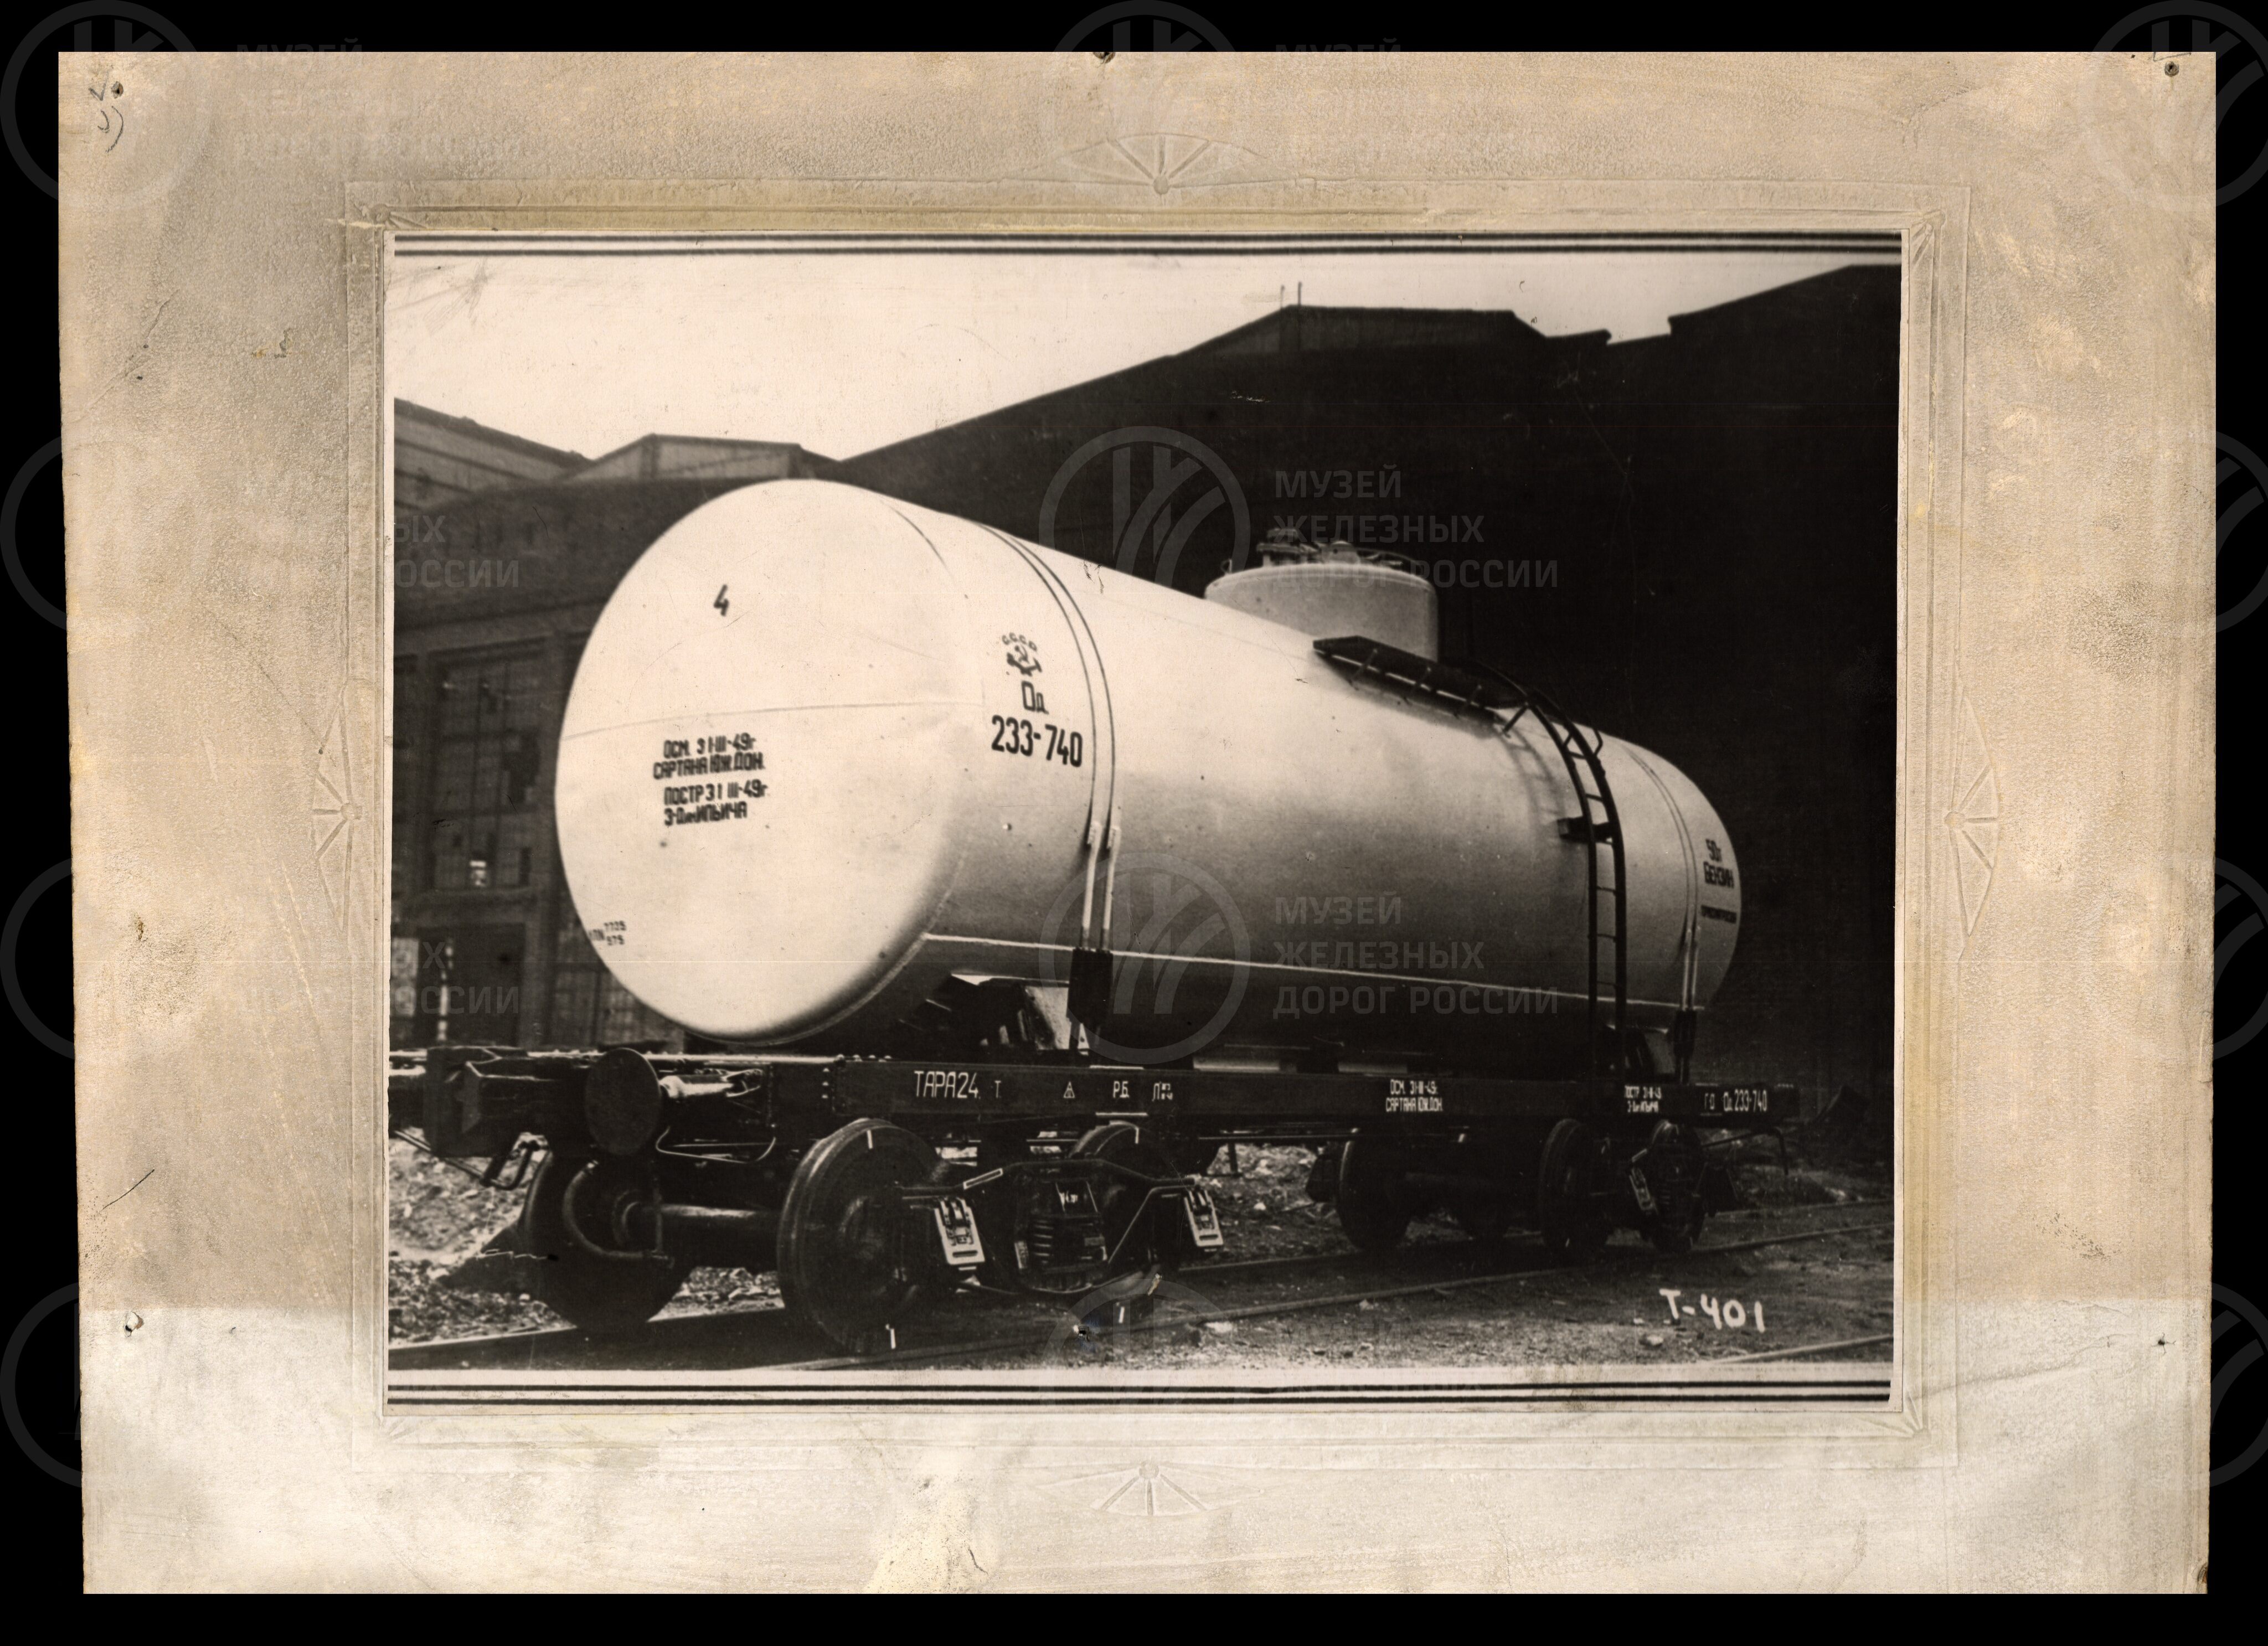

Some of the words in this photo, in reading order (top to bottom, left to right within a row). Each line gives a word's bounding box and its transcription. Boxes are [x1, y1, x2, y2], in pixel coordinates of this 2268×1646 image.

[714, 584, 729, 617] 4
[992, 715, 1083, 767] 233-740
[653, 757, 708, 780] САРТАНА
